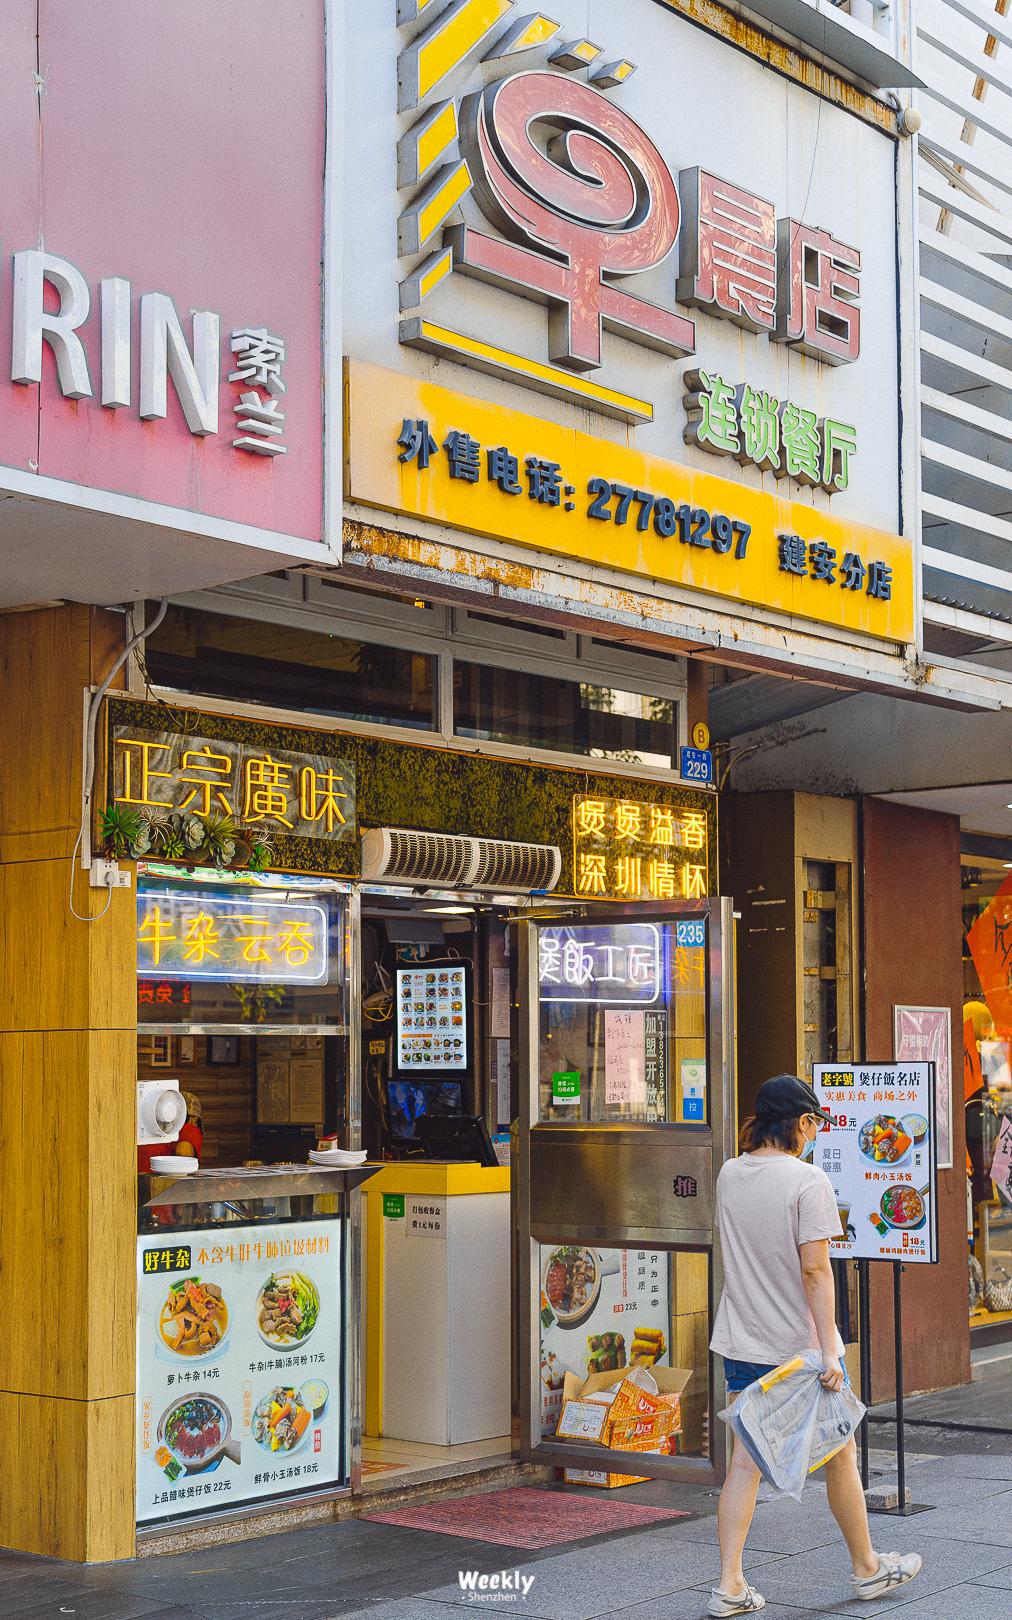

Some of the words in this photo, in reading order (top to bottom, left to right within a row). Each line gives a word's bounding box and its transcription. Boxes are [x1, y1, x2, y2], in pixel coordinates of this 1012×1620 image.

[11, 249, 220, 437] RIN
[228, 328, 287, 457] 索兰
[684, 368, 858, 495] 连锁餐厅
[397, 417, 575, 513] 外售电话:
[586, 476, 752, 560] 27781297
[777, 533, 893, 601] 建安分店
[697, 729, 705, 744] B
[687, 760, 708, 779] 229
[114, 739, 348, 833] 正宗廣味
[576, 799, 707, 850] 煲煲溢香
[577, 852, 708, 900] 深圳情怀
[137, 905, 315, 966] 牛杂云吞
[679, 924, 704, 944] 235
[822, 1073, 854, 1086] 老字號
[859, 1071, 920, 1087] 煲仔飯名店
[673, 1175, 698, 1199] 推
[144, 1248, 190, 1272] 好牛杂
[310, 1352, 326, 1365] 17元
[167, 1371, 200, 1386] 萝卜牛杂
[203, 1367, 220, 1380] 14元
[303, 1462, 319, 1474] 18元
[213, 1480, 232, 1492] 22元
